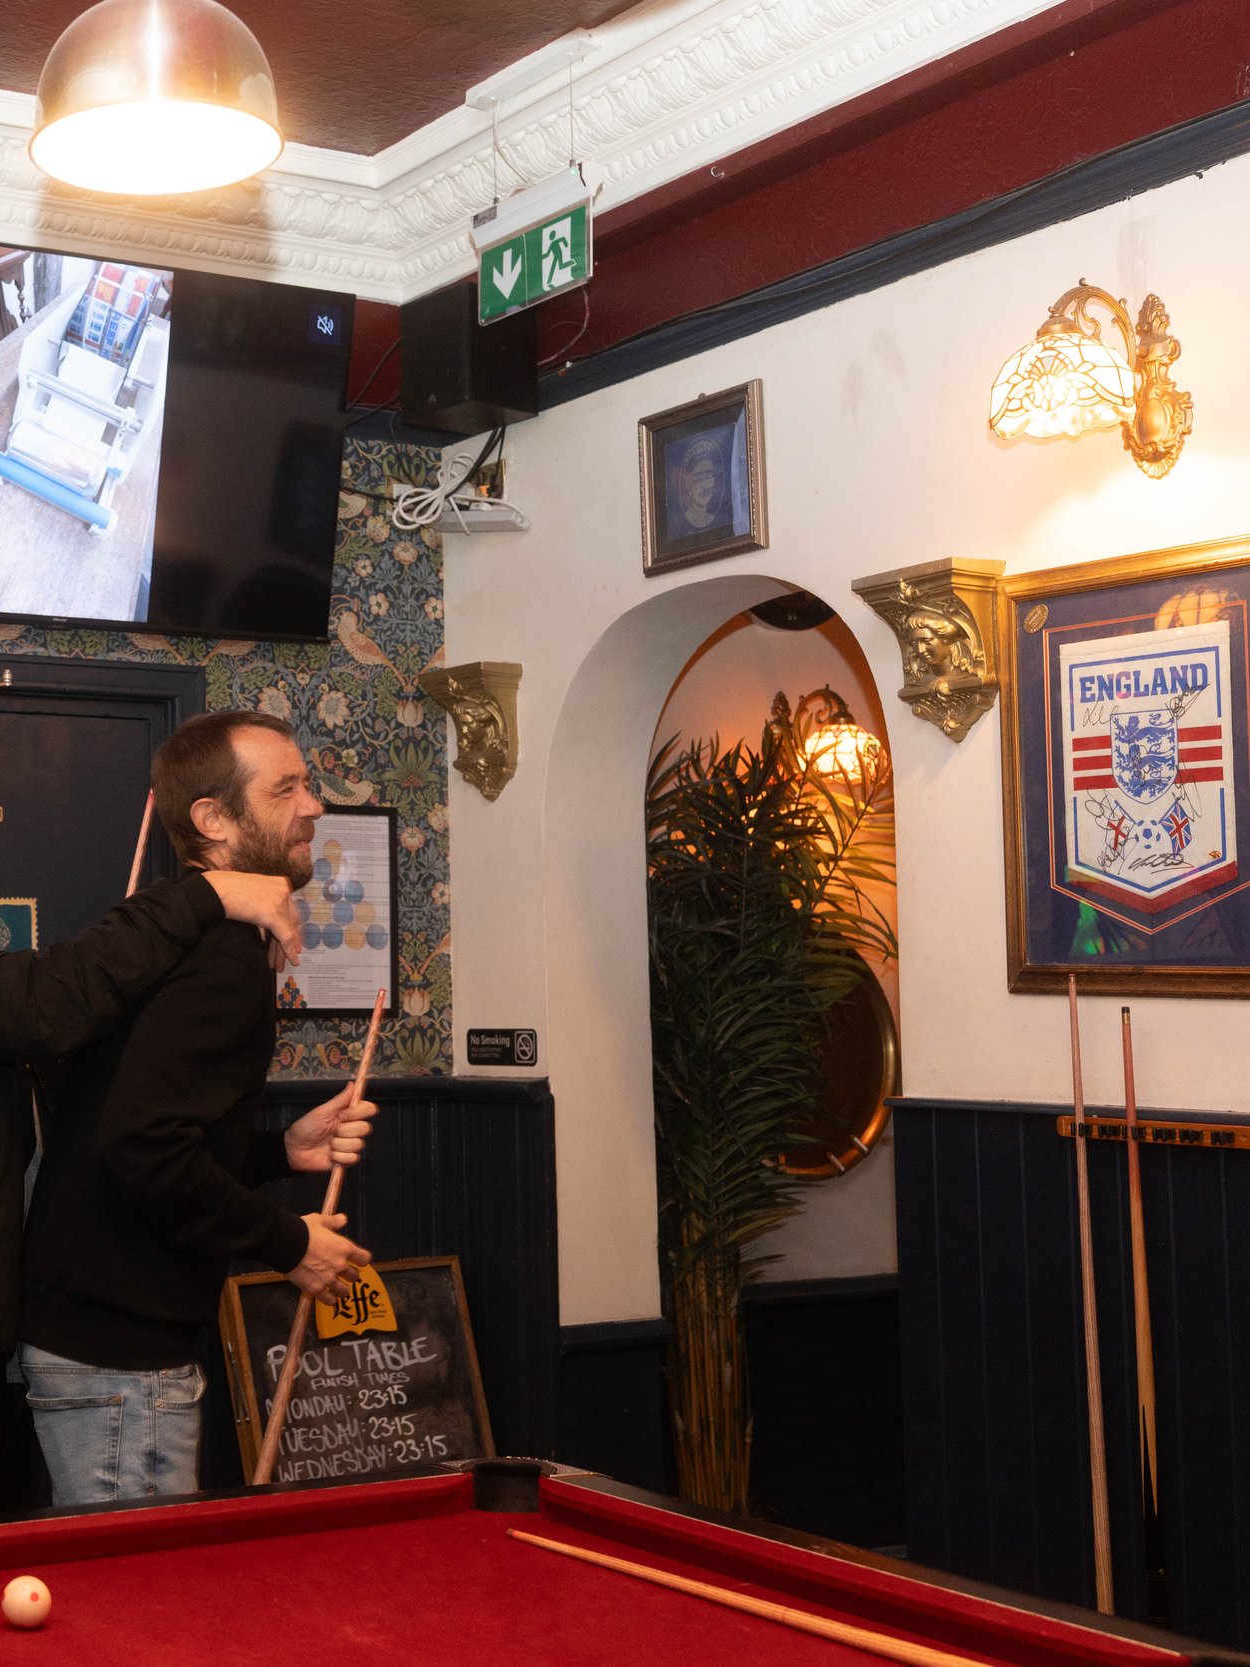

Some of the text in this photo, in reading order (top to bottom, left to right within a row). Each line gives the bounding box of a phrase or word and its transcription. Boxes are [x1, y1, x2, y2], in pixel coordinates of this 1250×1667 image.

[1079, 662, 1209, 704] ENGLAND
[470, 1034, 511, 1048] No Smoking
[340, 1336, 438, 1371] TABLE
[310, 1371, 410, 1390] FINISH TIMES
[358, 1385, 407, 1410] 23:15
[368, 1413, 418, 1439] 23:15
[393, 1435, 448, 1463] 23:15
